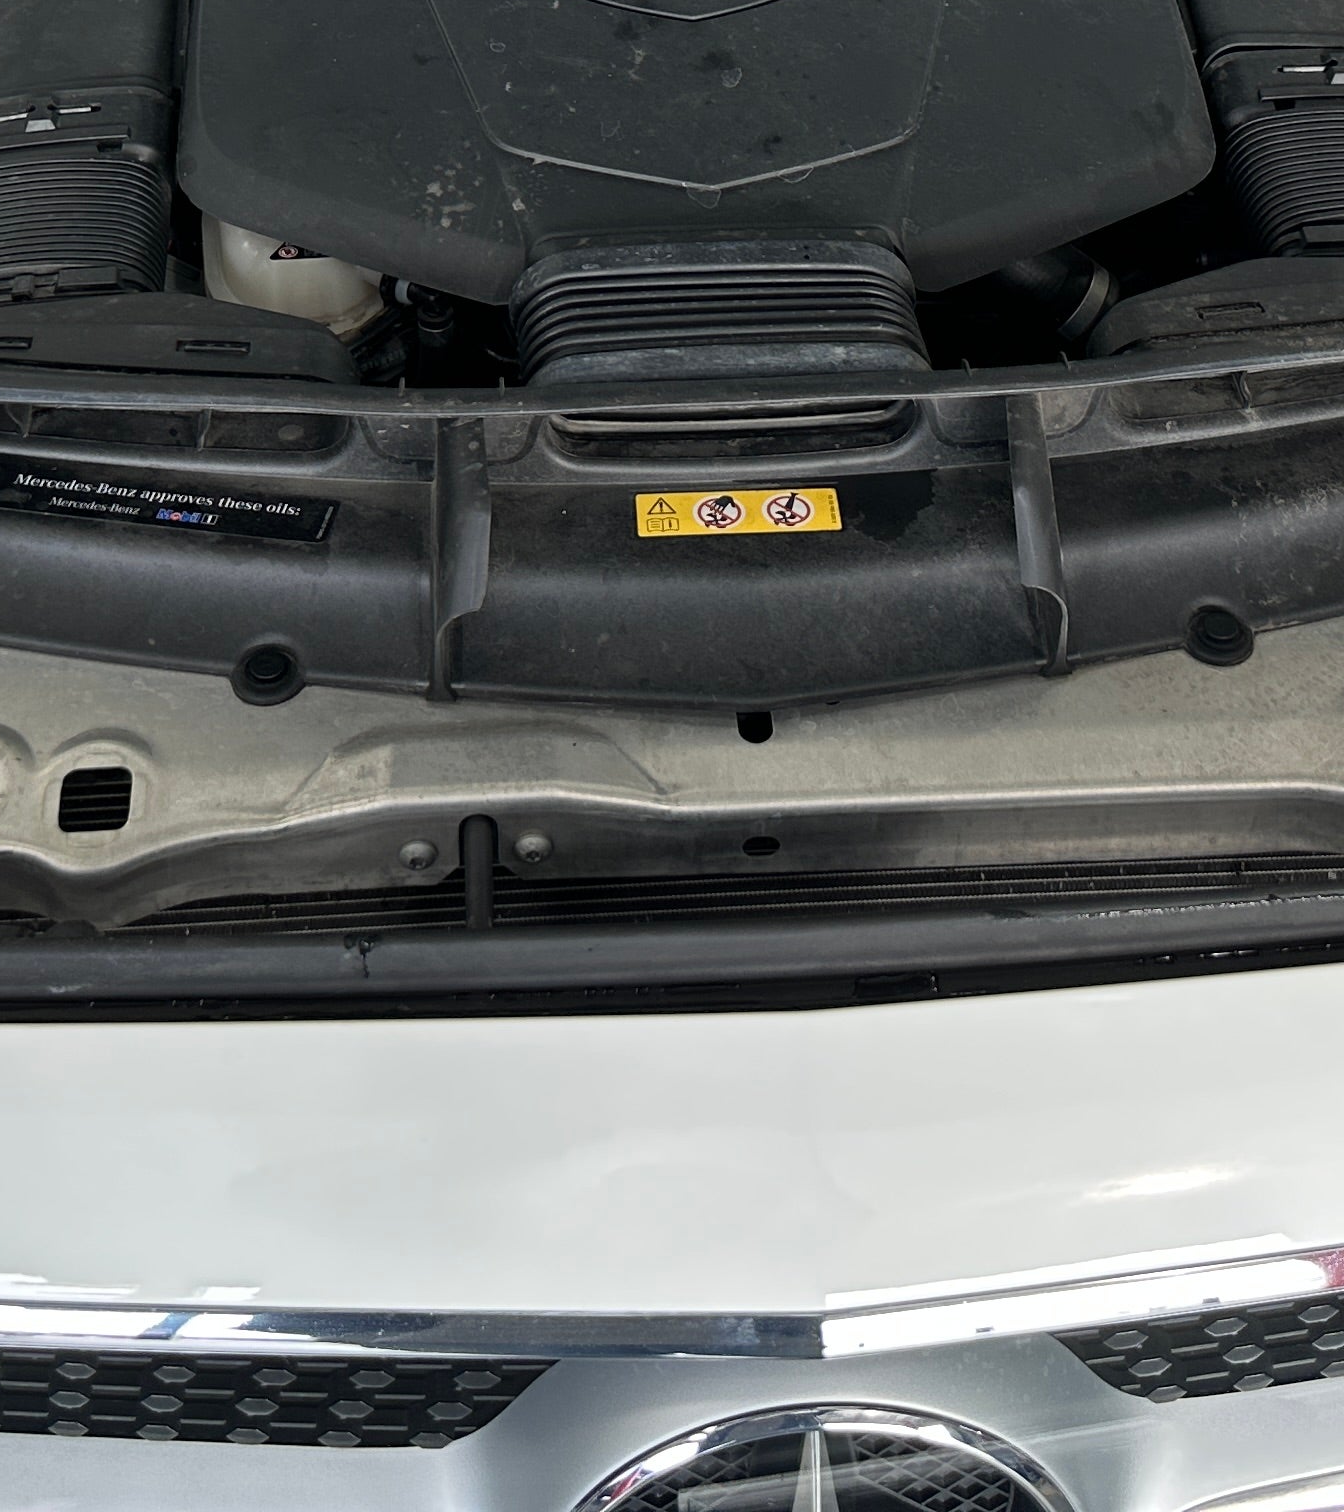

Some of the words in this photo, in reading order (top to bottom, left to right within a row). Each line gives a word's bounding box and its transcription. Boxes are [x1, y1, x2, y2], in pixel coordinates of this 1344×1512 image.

[13, 473, 138, 498] Mercedes-Benz
[139, 489, 215, 506] approves
[217, 496, 263, 512] these
[265, 502, 302, 516] oils:
[48, 496, 141, 515] Mercedes-Benz
[156, 508, 201, 524] Mobil
